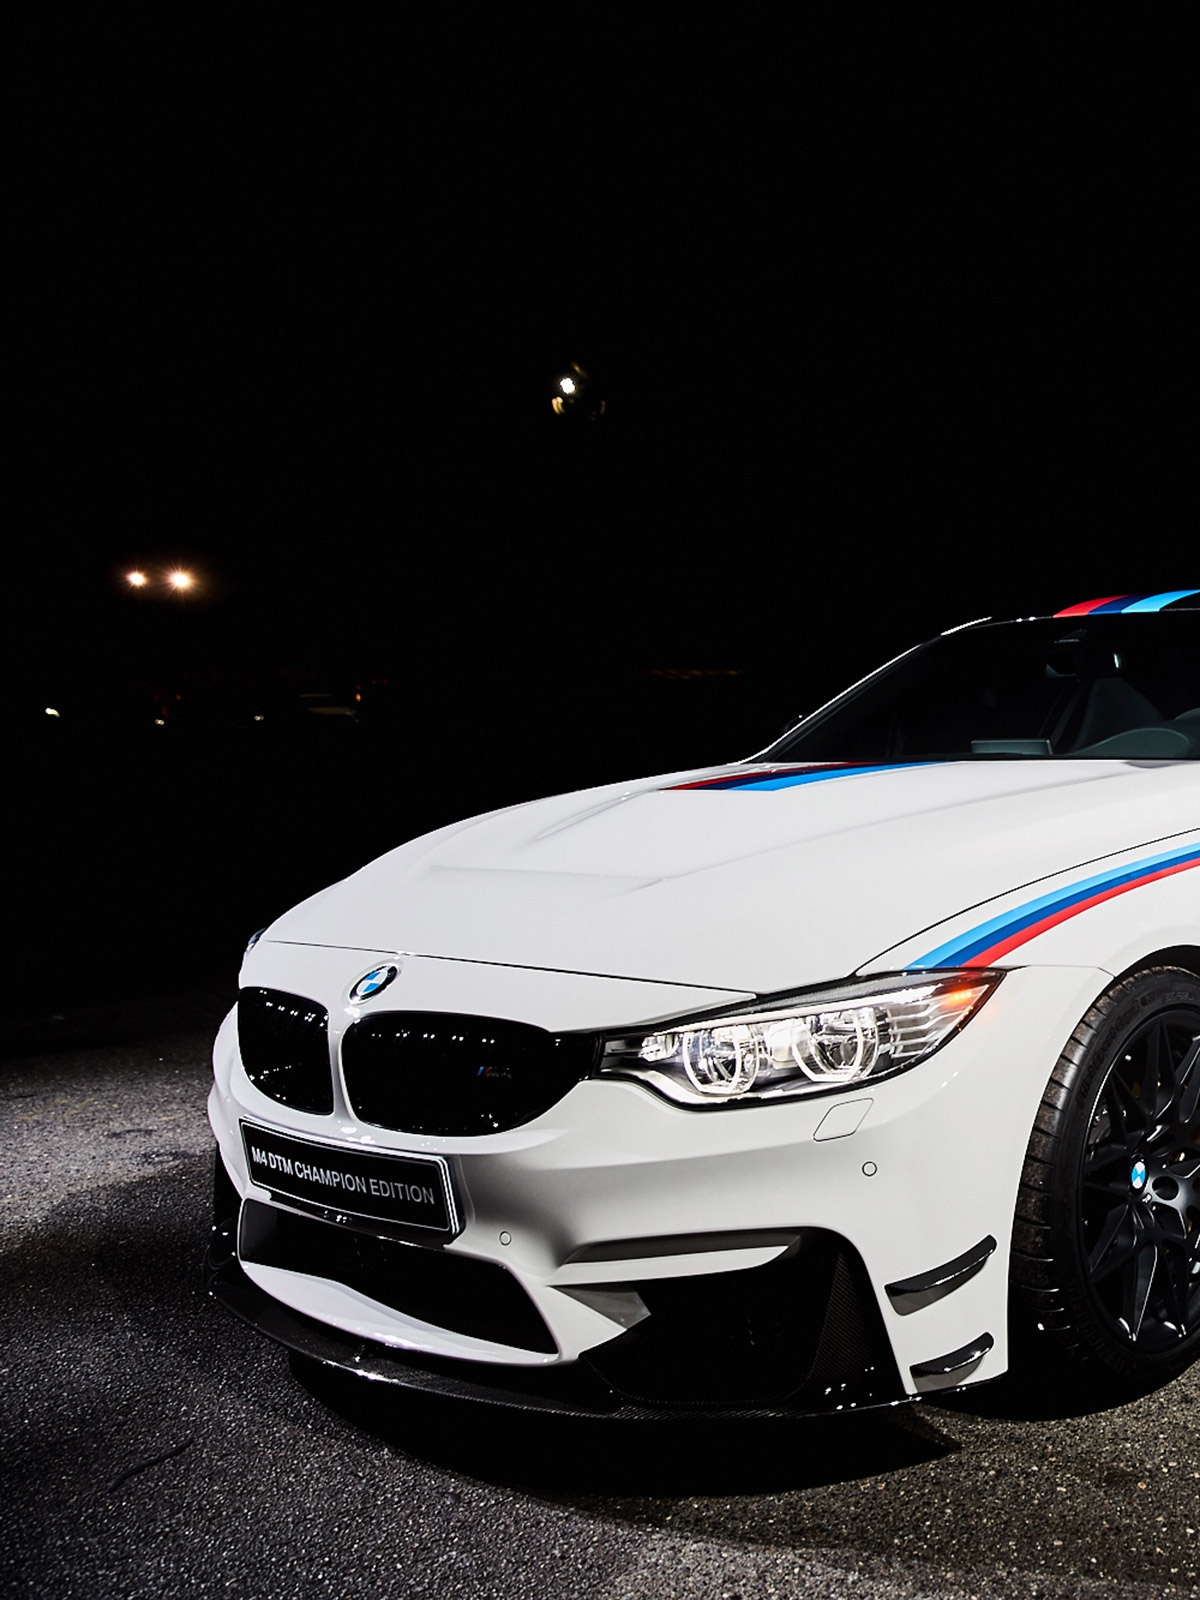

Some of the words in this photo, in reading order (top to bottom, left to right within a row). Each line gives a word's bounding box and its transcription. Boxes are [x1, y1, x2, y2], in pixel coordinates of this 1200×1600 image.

[252, 1146, 268, 1167] M4
[268, 1152, 293, 1176] DTM
[294, 1161, 367, 1194] CHAMPION
[370, 1178, 435, 1204] EDITION
